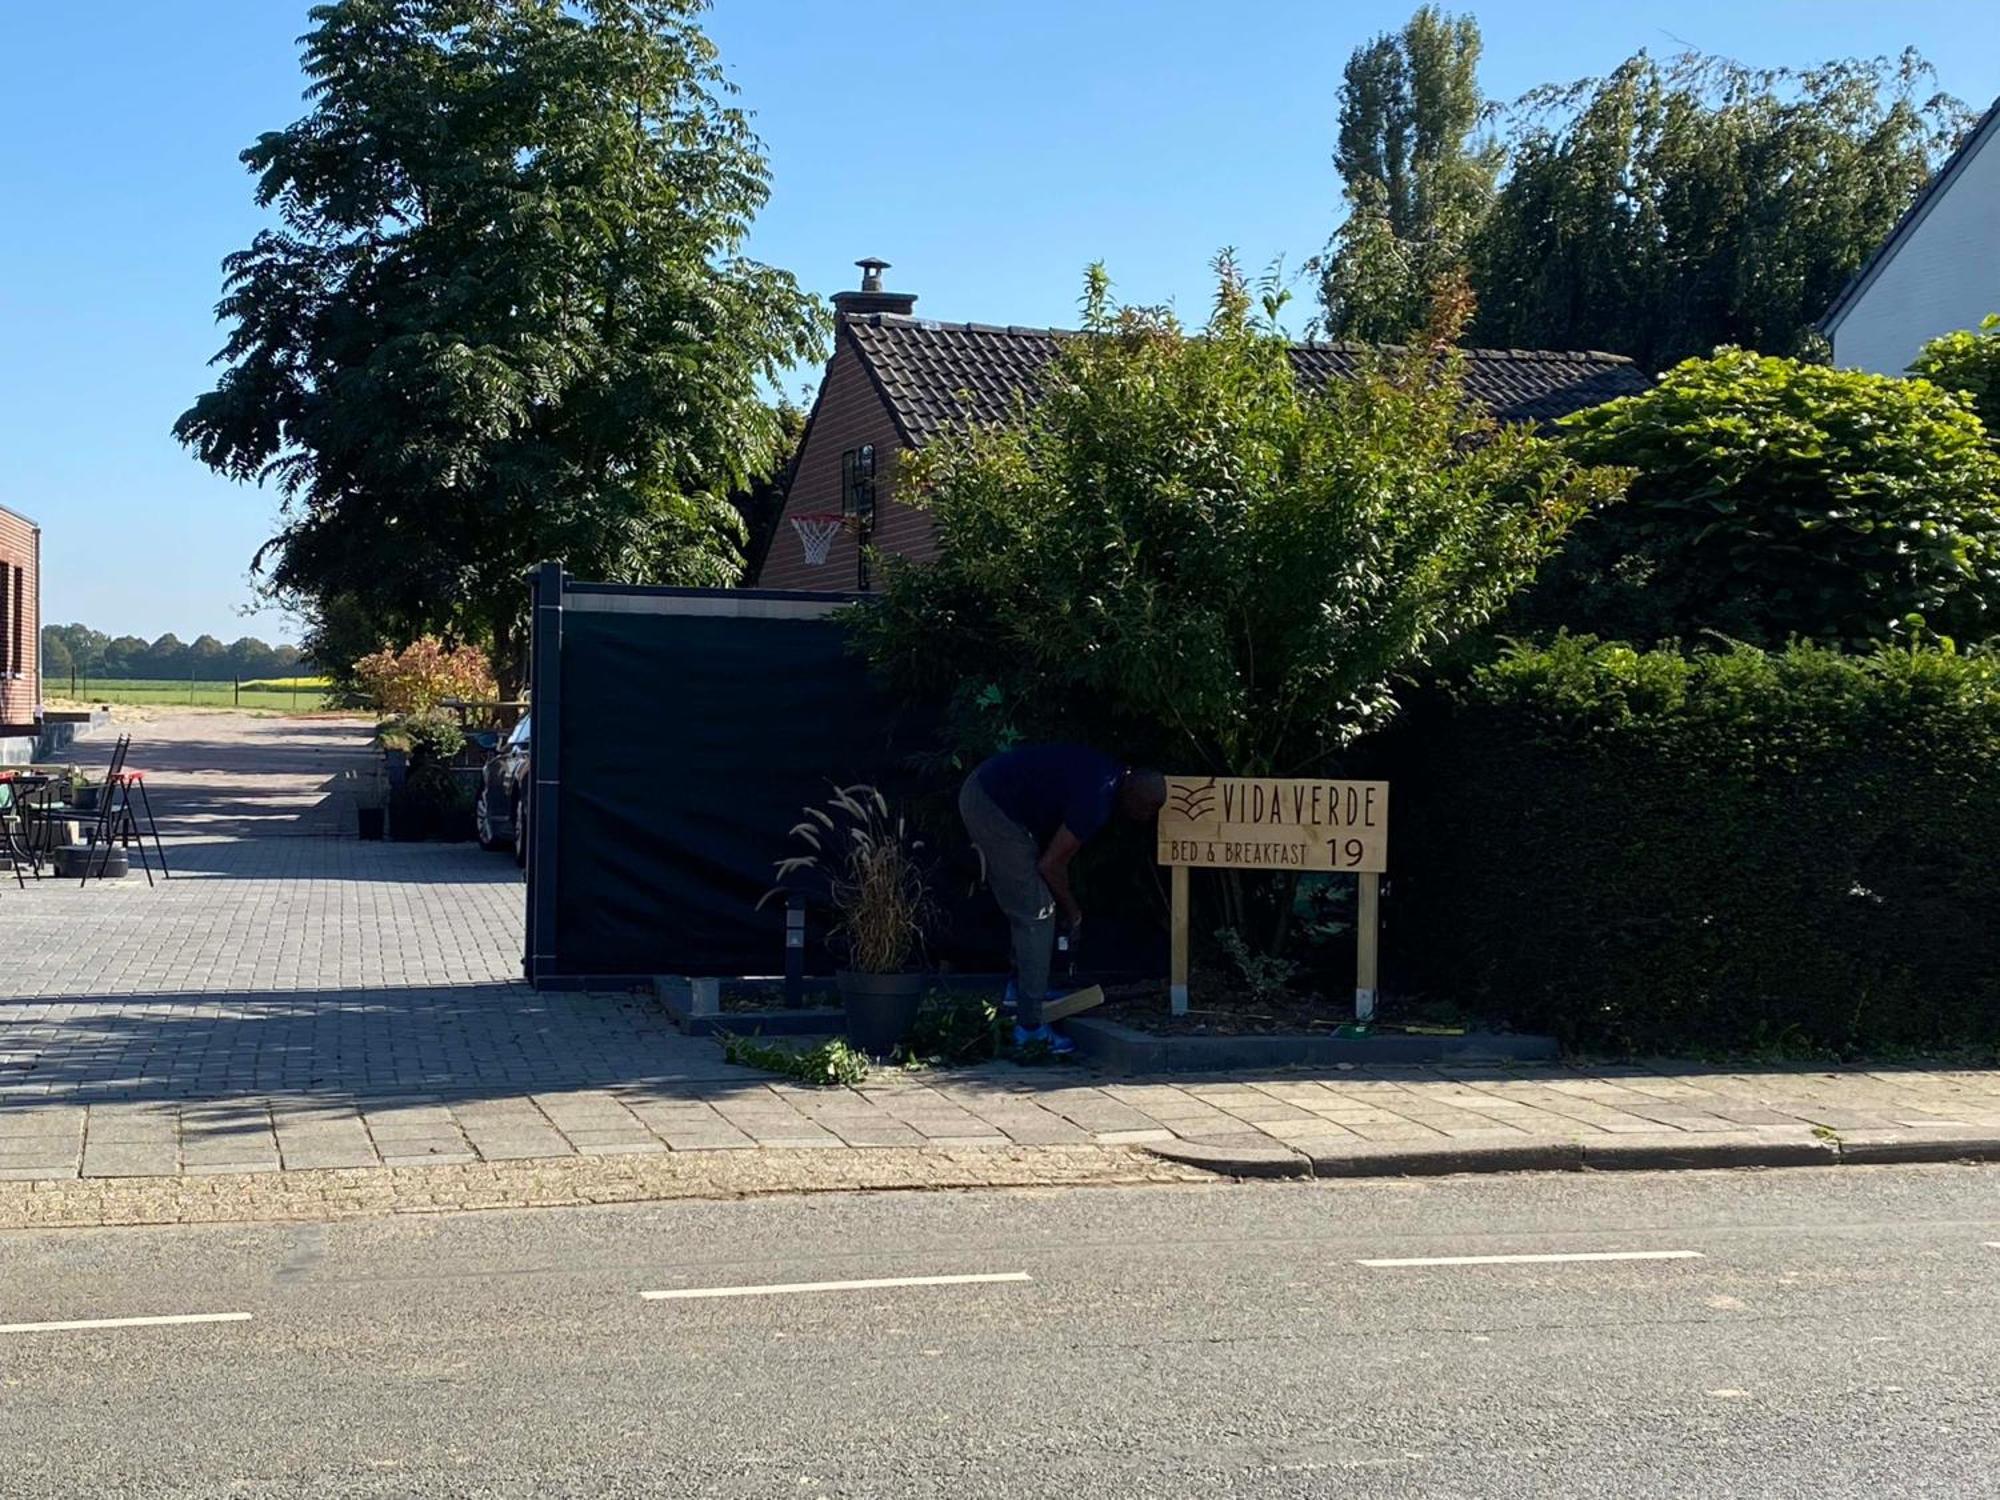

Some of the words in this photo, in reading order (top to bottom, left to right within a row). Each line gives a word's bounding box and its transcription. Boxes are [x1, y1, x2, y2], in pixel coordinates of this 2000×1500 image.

[1223, 783, 1281, 824] VIDA
[1293, 785, 1376, 827] VERDE
[1171, 840, 1198, 862] BED
[1207, 842, 1216, 863] &
[1225, 842, 1308, 866] BREAKFAST
[1326, 838, 1364, 867] 19
